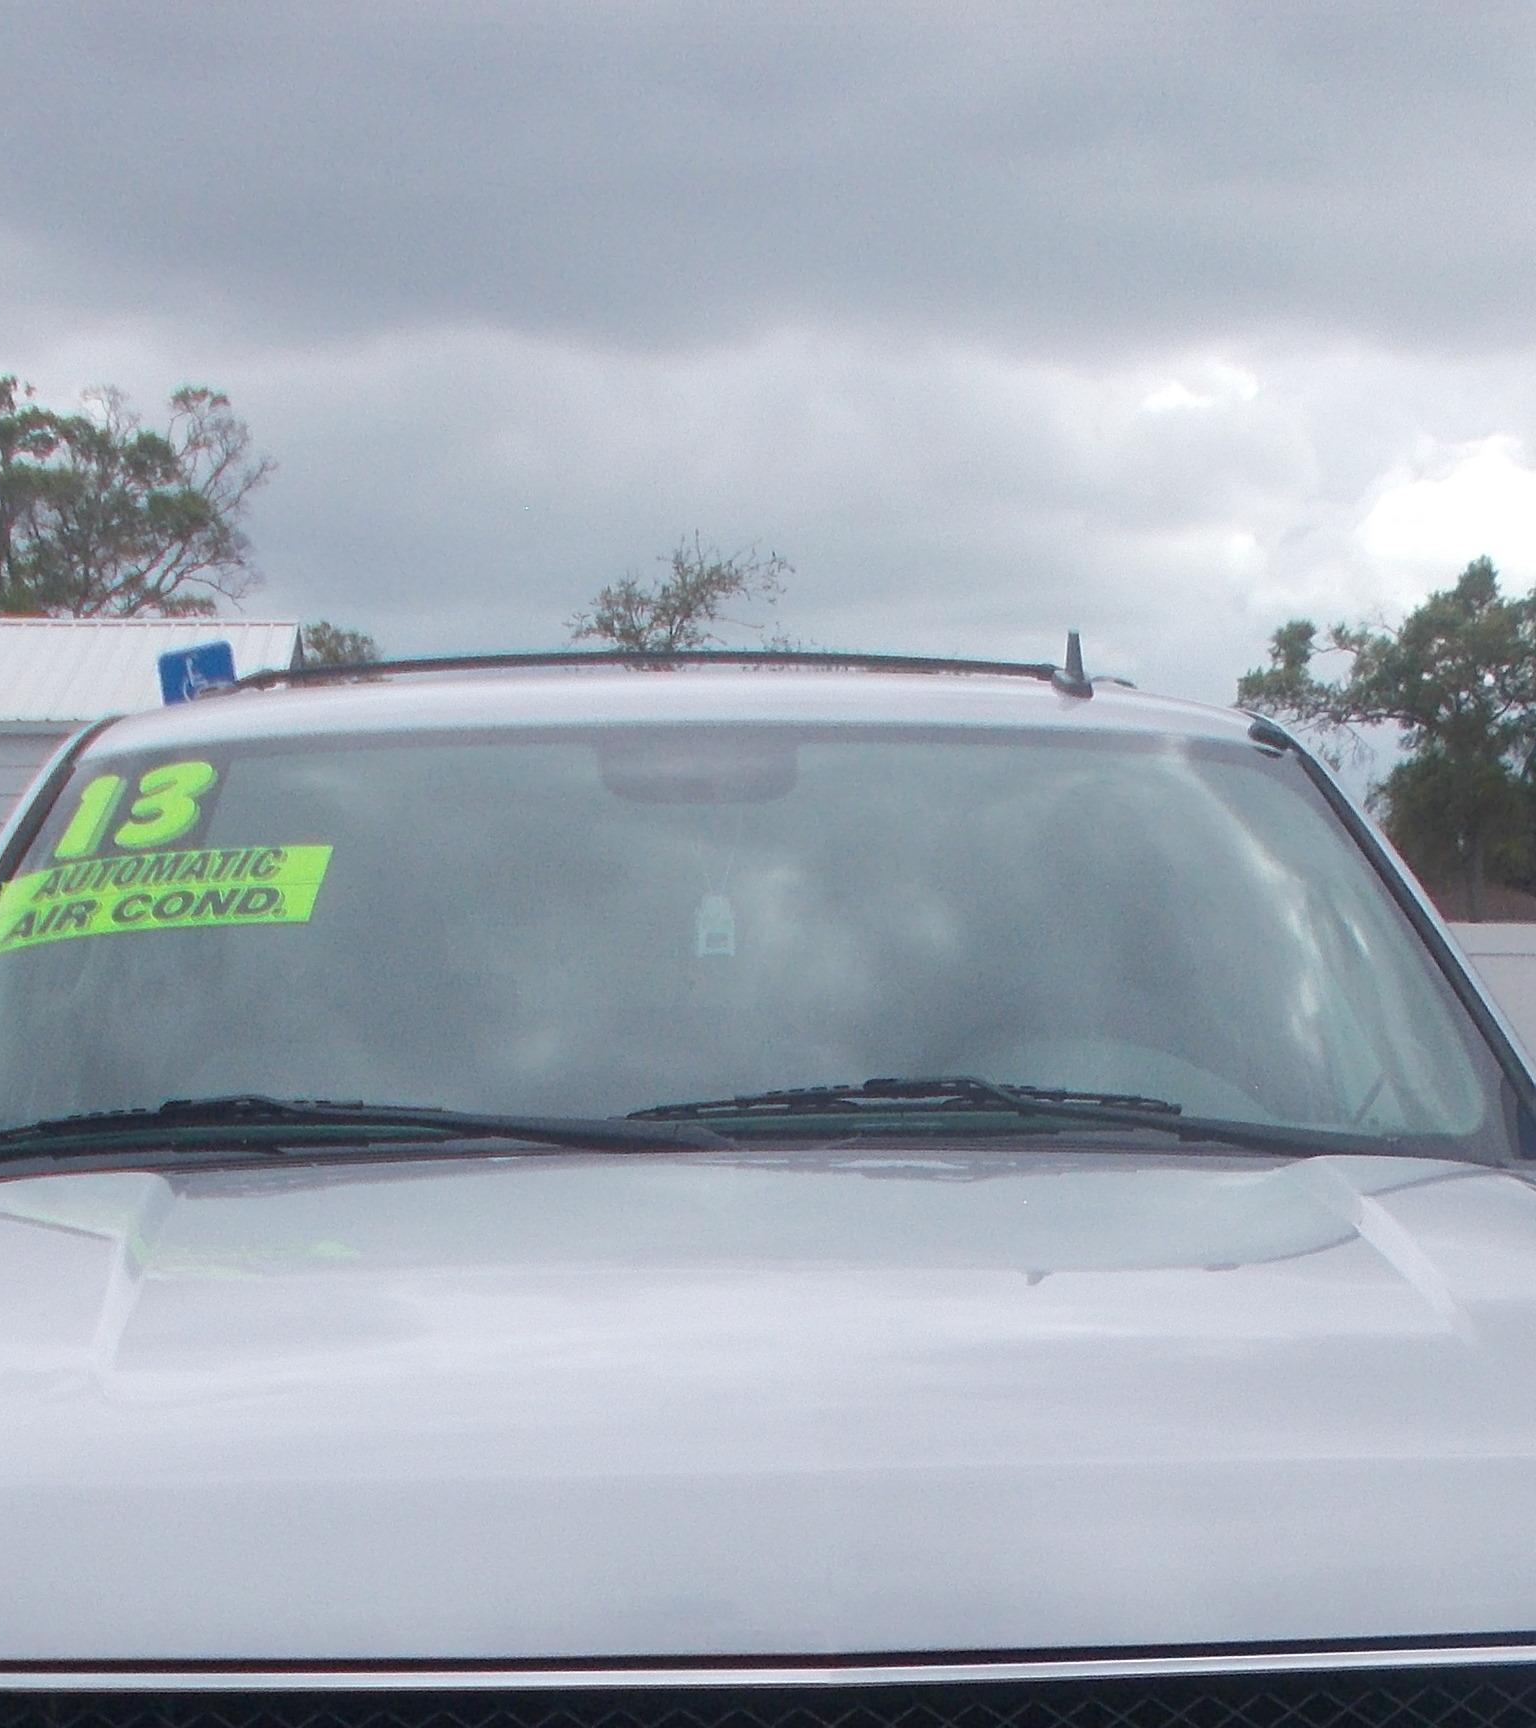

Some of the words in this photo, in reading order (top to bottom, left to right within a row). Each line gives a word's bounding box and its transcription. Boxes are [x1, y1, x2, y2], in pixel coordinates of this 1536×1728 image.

[55, 761, 217, 858] 13
[33, 848, 287, 900] AUTOMATIC
[113, 886, 287, 923] COND.
